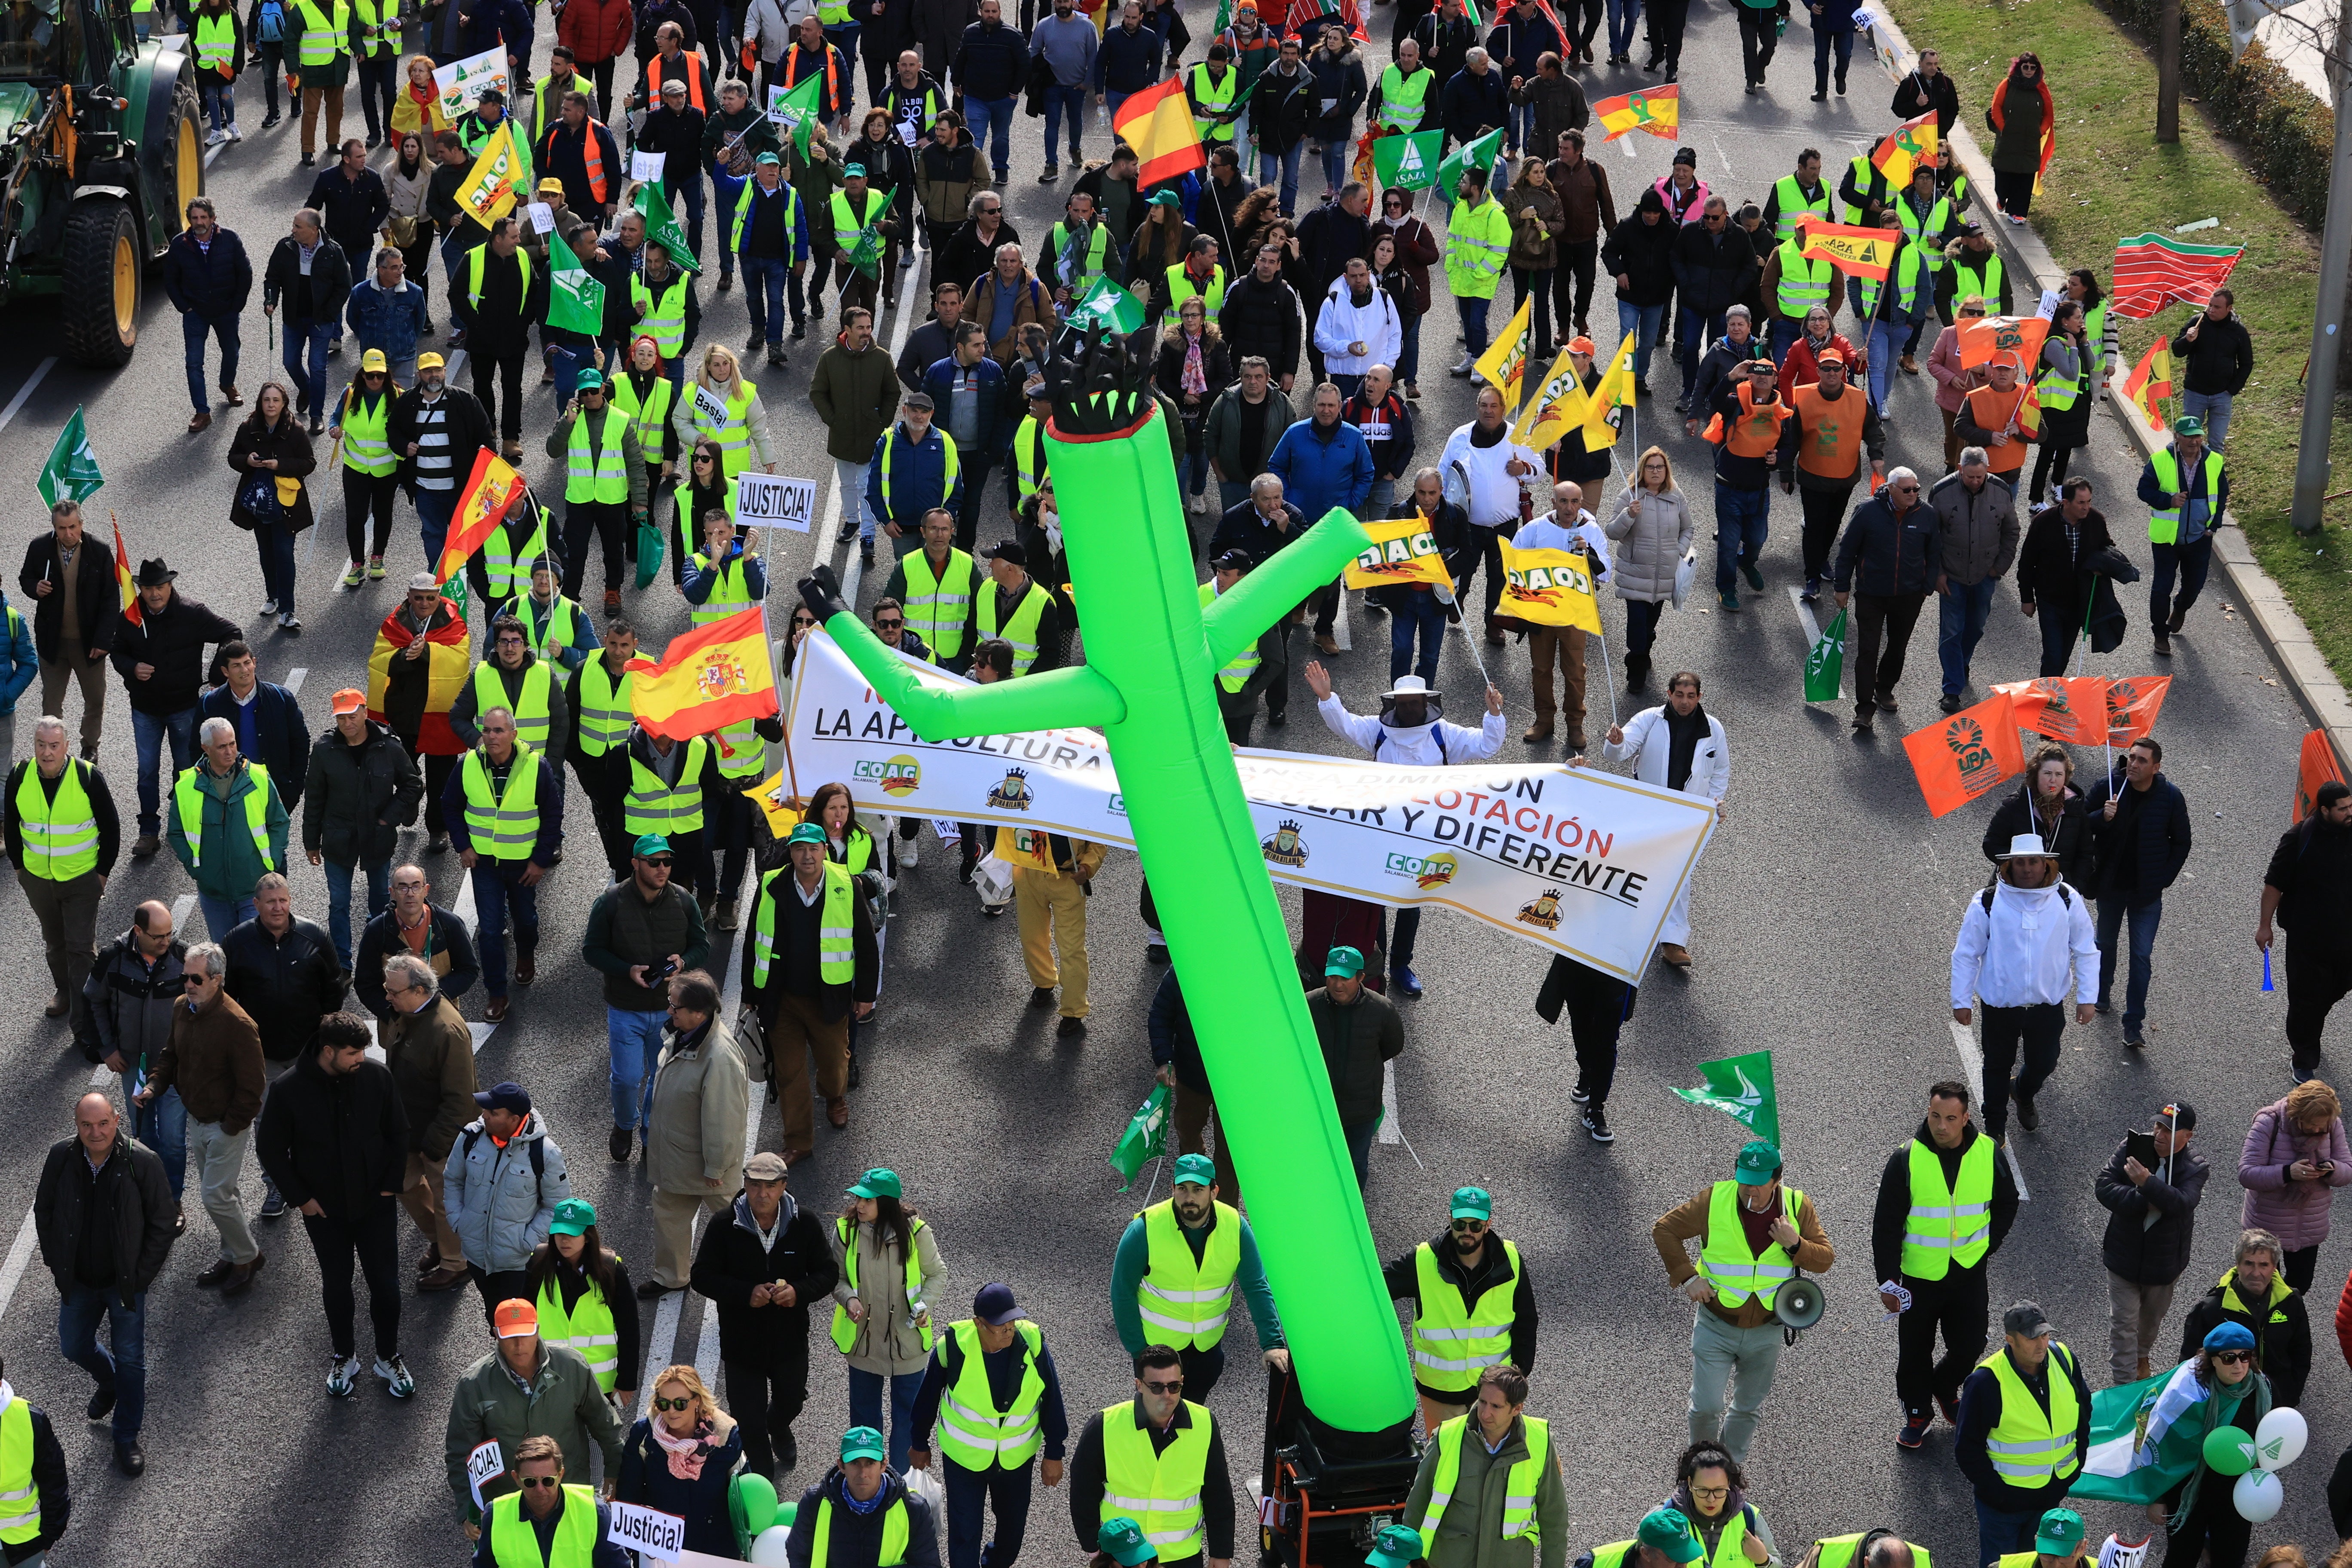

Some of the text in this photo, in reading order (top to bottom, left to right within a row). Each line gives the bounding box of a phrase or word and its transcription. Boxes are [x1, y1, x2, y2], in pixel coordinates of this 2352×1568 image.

[446, 105, 467, 117] UPA
[1395, 171, 1426, 185] ASAJA
[1997, 334, 2023, 346] UPA
[694, 393, 726, 429] Basta!
[71, 466, 98, 475] Asociación
[739, 481, 812, 520] ¡JUSTICIA!
[815, 708, 851, 737] LA
[2038, 716, 2076, 732] Agricultores
[2043, 723, 2076, 737] Ganaderos
[1957, 747, 1994, 772] UPA
[855, 761, 916, 779] COAG
[1964, 770, 2001, 790] Agricultores
[991, 797, 1025, 808] REINA KILAMA
[1264, 850, 1300, 864] REINA KILAMA
[1402, 805, 1424, 832] Y
[1434, 815, 1648, 903] DIFERENTE
[1389, 854, 1453, 878] COAG
[1384, 869, 1414, 880] SALAMANCA
[1521, 913, 1553, 926] REINA KILAMA
[614, 1506, 682, 1553] Justicia!
